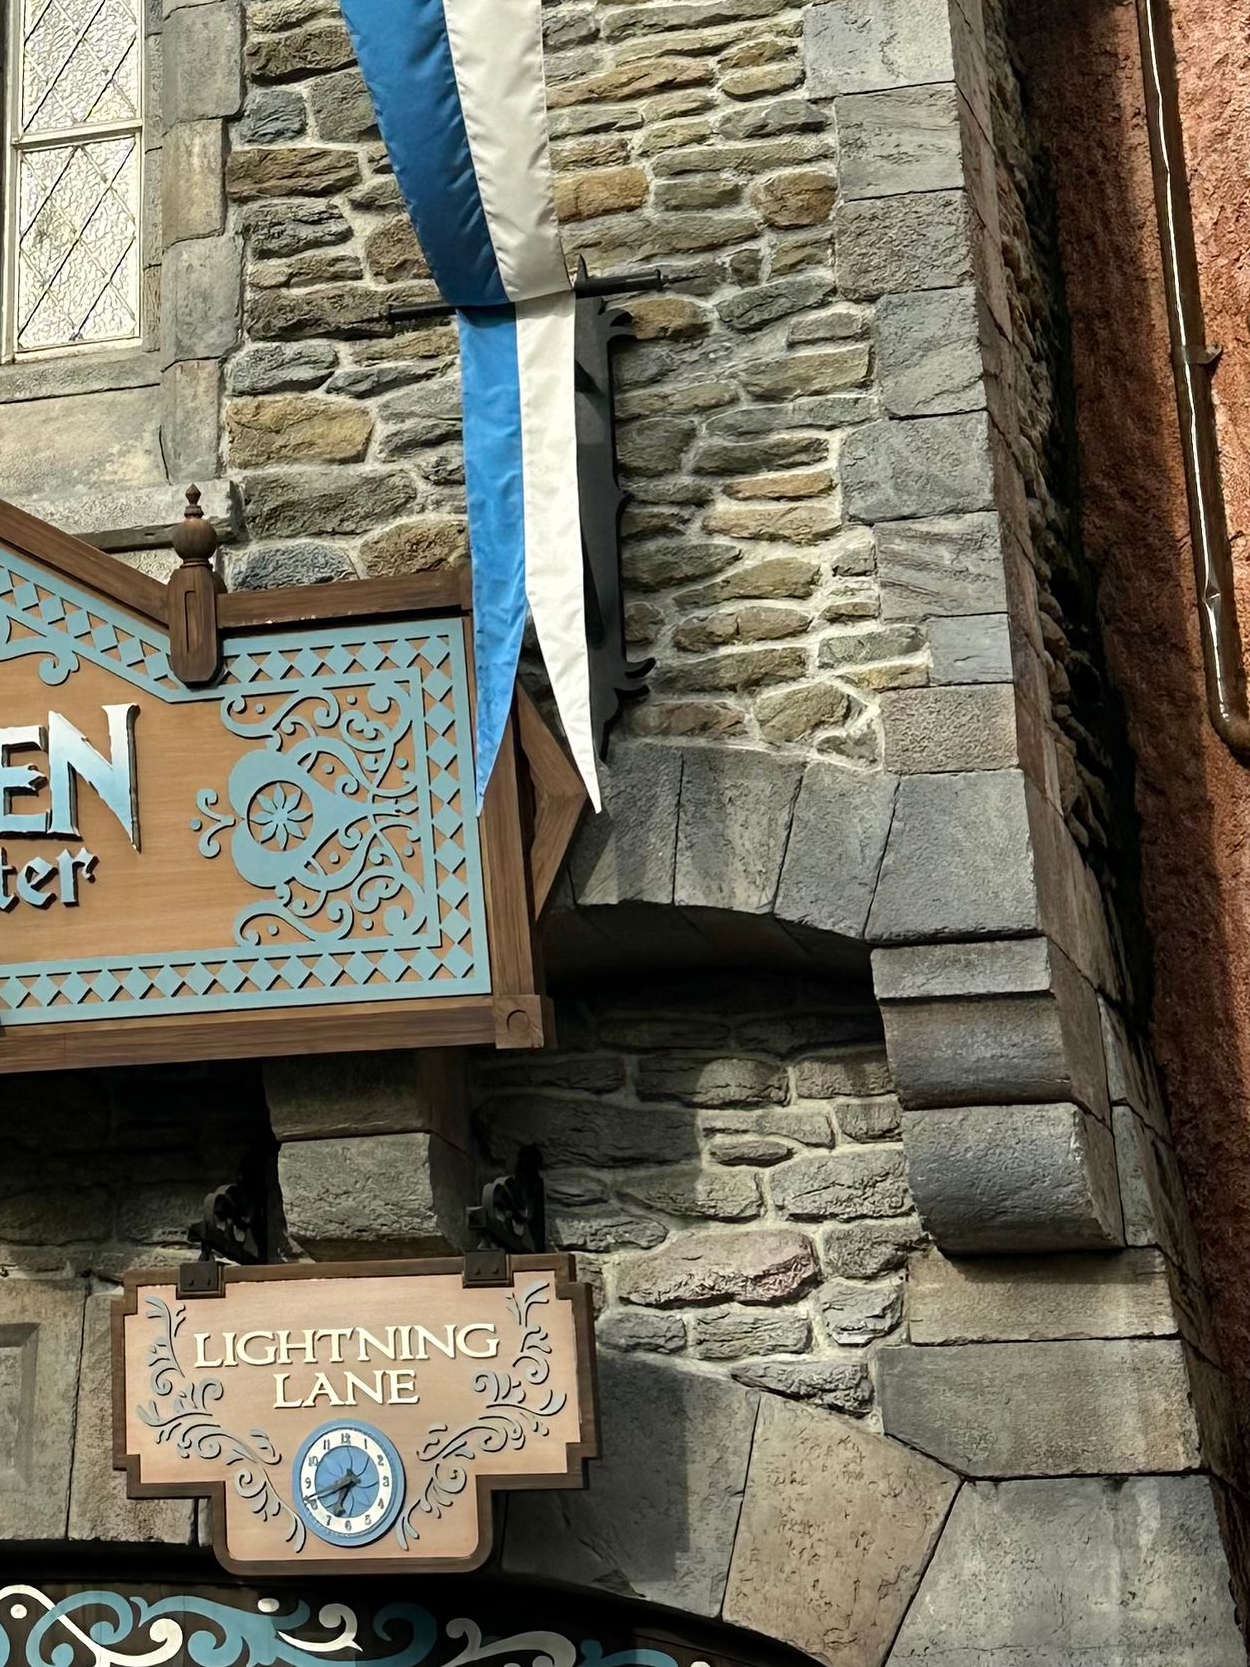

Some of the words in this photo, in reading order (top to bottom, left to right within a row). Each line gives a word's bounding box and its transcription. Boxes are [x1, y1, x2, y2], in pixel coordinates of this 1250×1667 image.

[194, 1323, 500, 1368] LIGHTNING
[273, 1369, 420, 1408] LANE
[323, 1439, 330, 1450] 11
[364, 1438, 368, 1450] 1
[377, 1455, 384, 1466] 2
[305, 1477, 312, 1489] 9
[382, 1476, 390, 1487] 3
[377, 1498, 384, 1509] 4
[326, 1515, 332, 1526] 7
[345, 1520, 352, 1531] 6
[365, 1515, 371, 1525] 5
